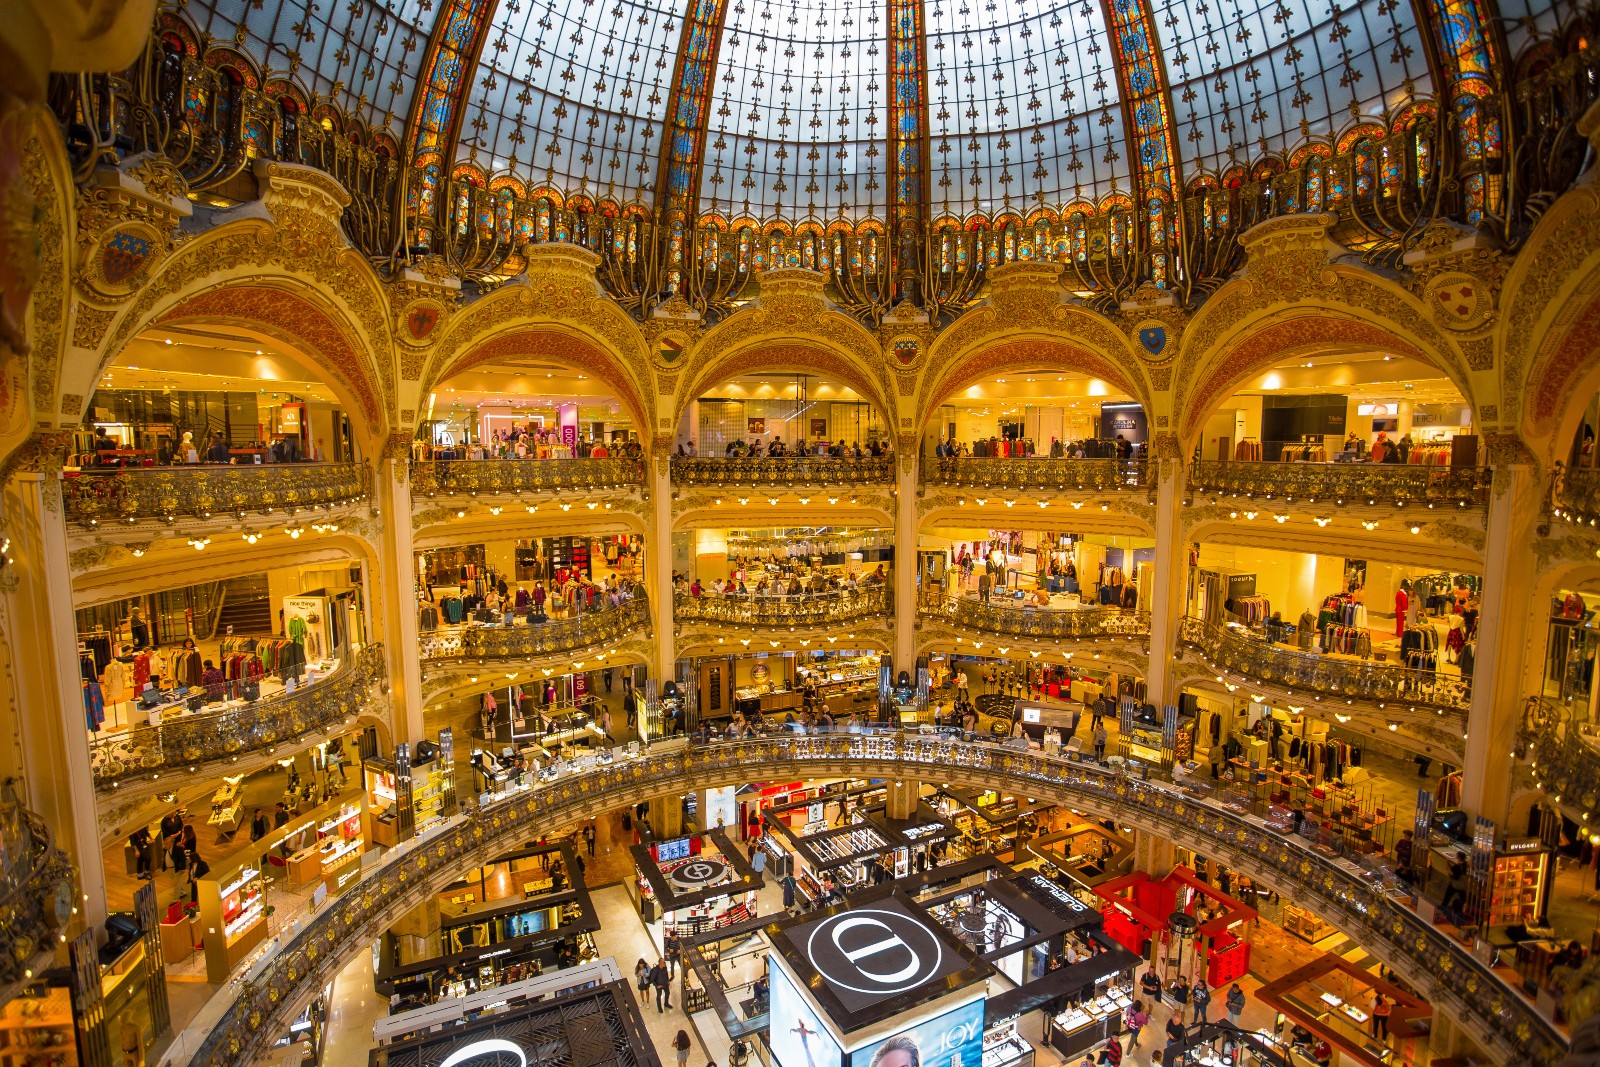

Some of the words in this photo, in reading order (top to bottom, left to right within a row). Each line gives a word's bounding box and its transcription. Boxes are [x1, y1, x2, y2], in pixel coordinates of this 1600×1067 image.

[301, 600, 316, 608] things
[1030, 875, 1085, 912] GUERLAIN
[992, 1011, 1021, 1028] GUERLAIN
[935, 1017, 979, 1056] JOY
